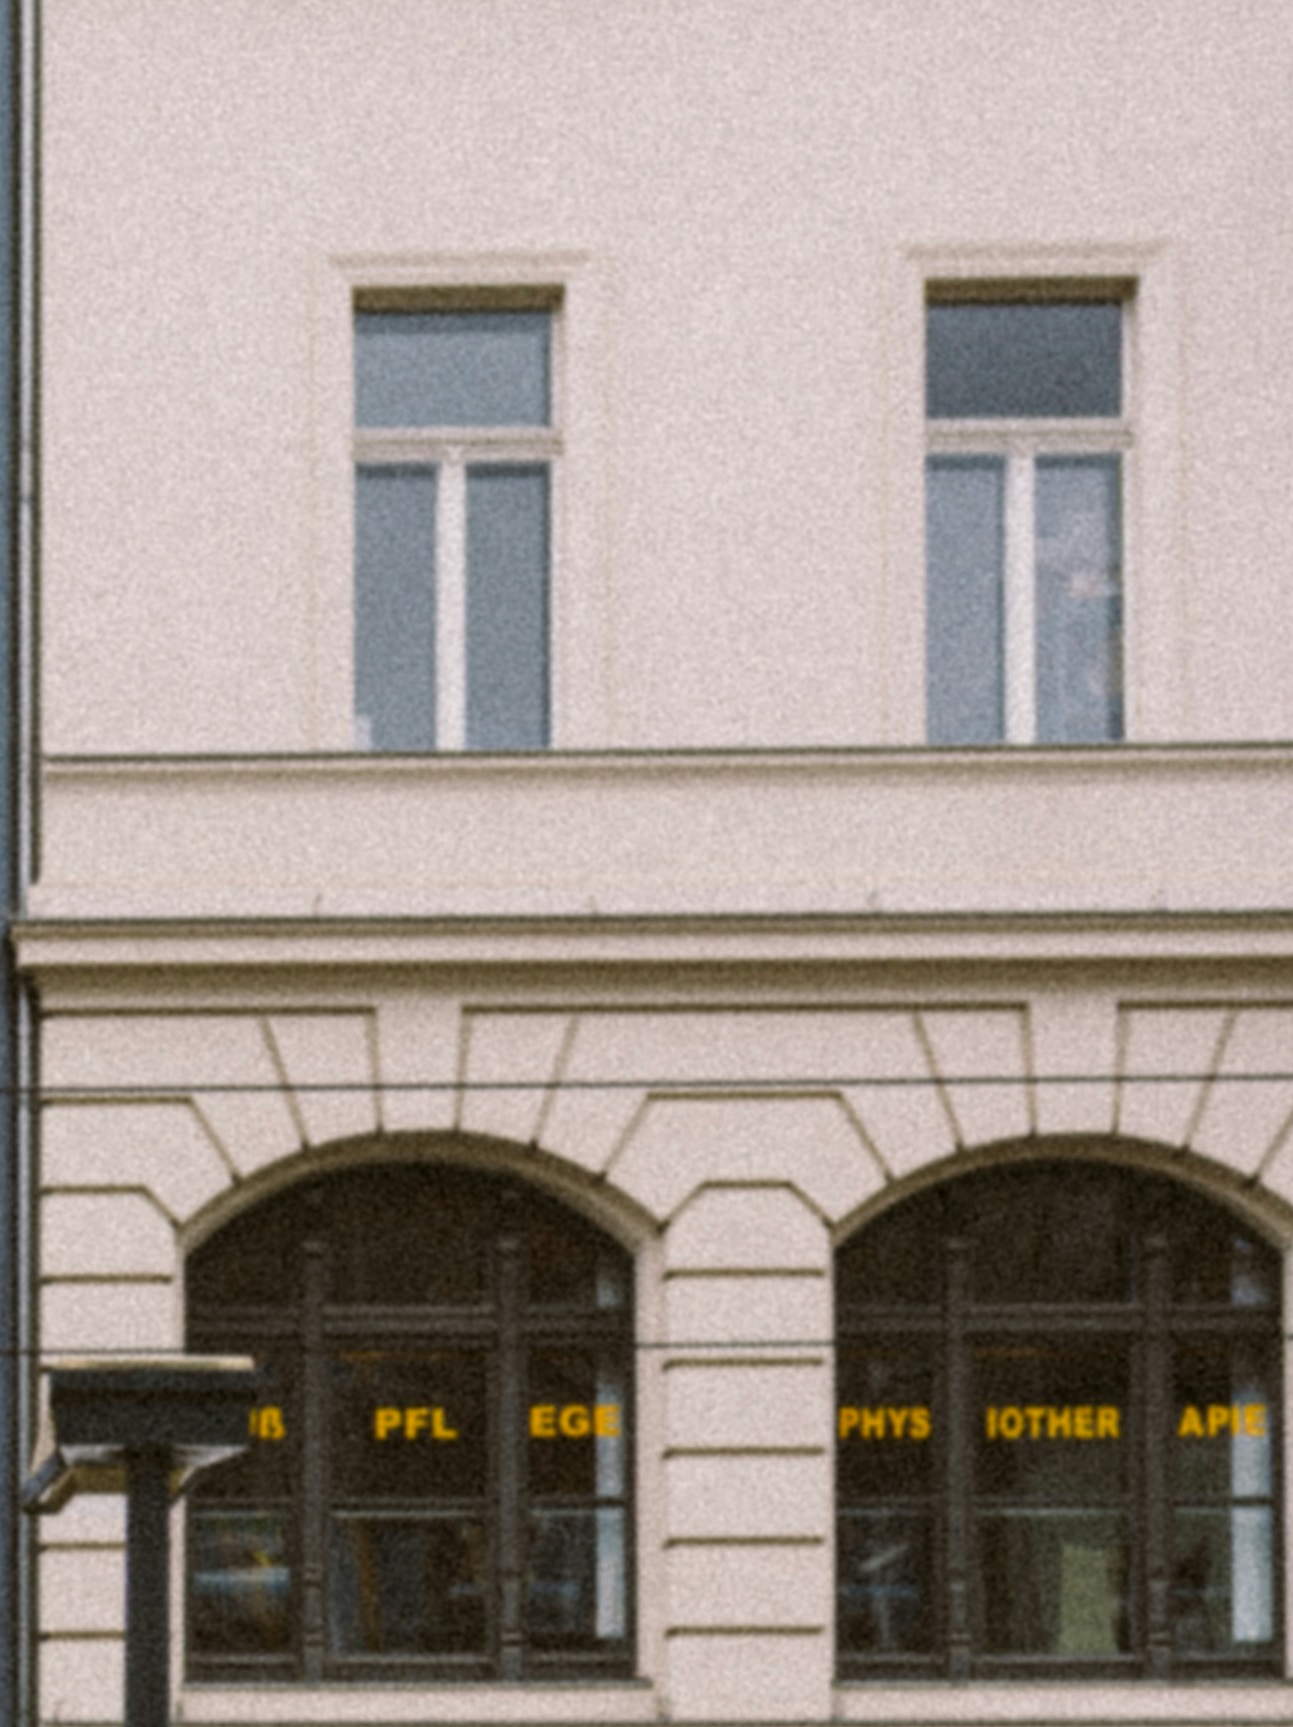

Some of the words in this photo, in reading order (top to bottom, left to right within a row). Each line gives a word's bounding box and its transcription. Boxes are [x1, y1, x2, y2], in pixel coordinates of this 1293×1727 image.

[374, 1407, 459, 1441] PFL
[528, 1404, 621, 1438] EGE
[838, 1406, 933, 1440] PHYS
[986, 1405, 1121, 1440] IOTHER
[1178, 1403, 1266, 1438] APIE
